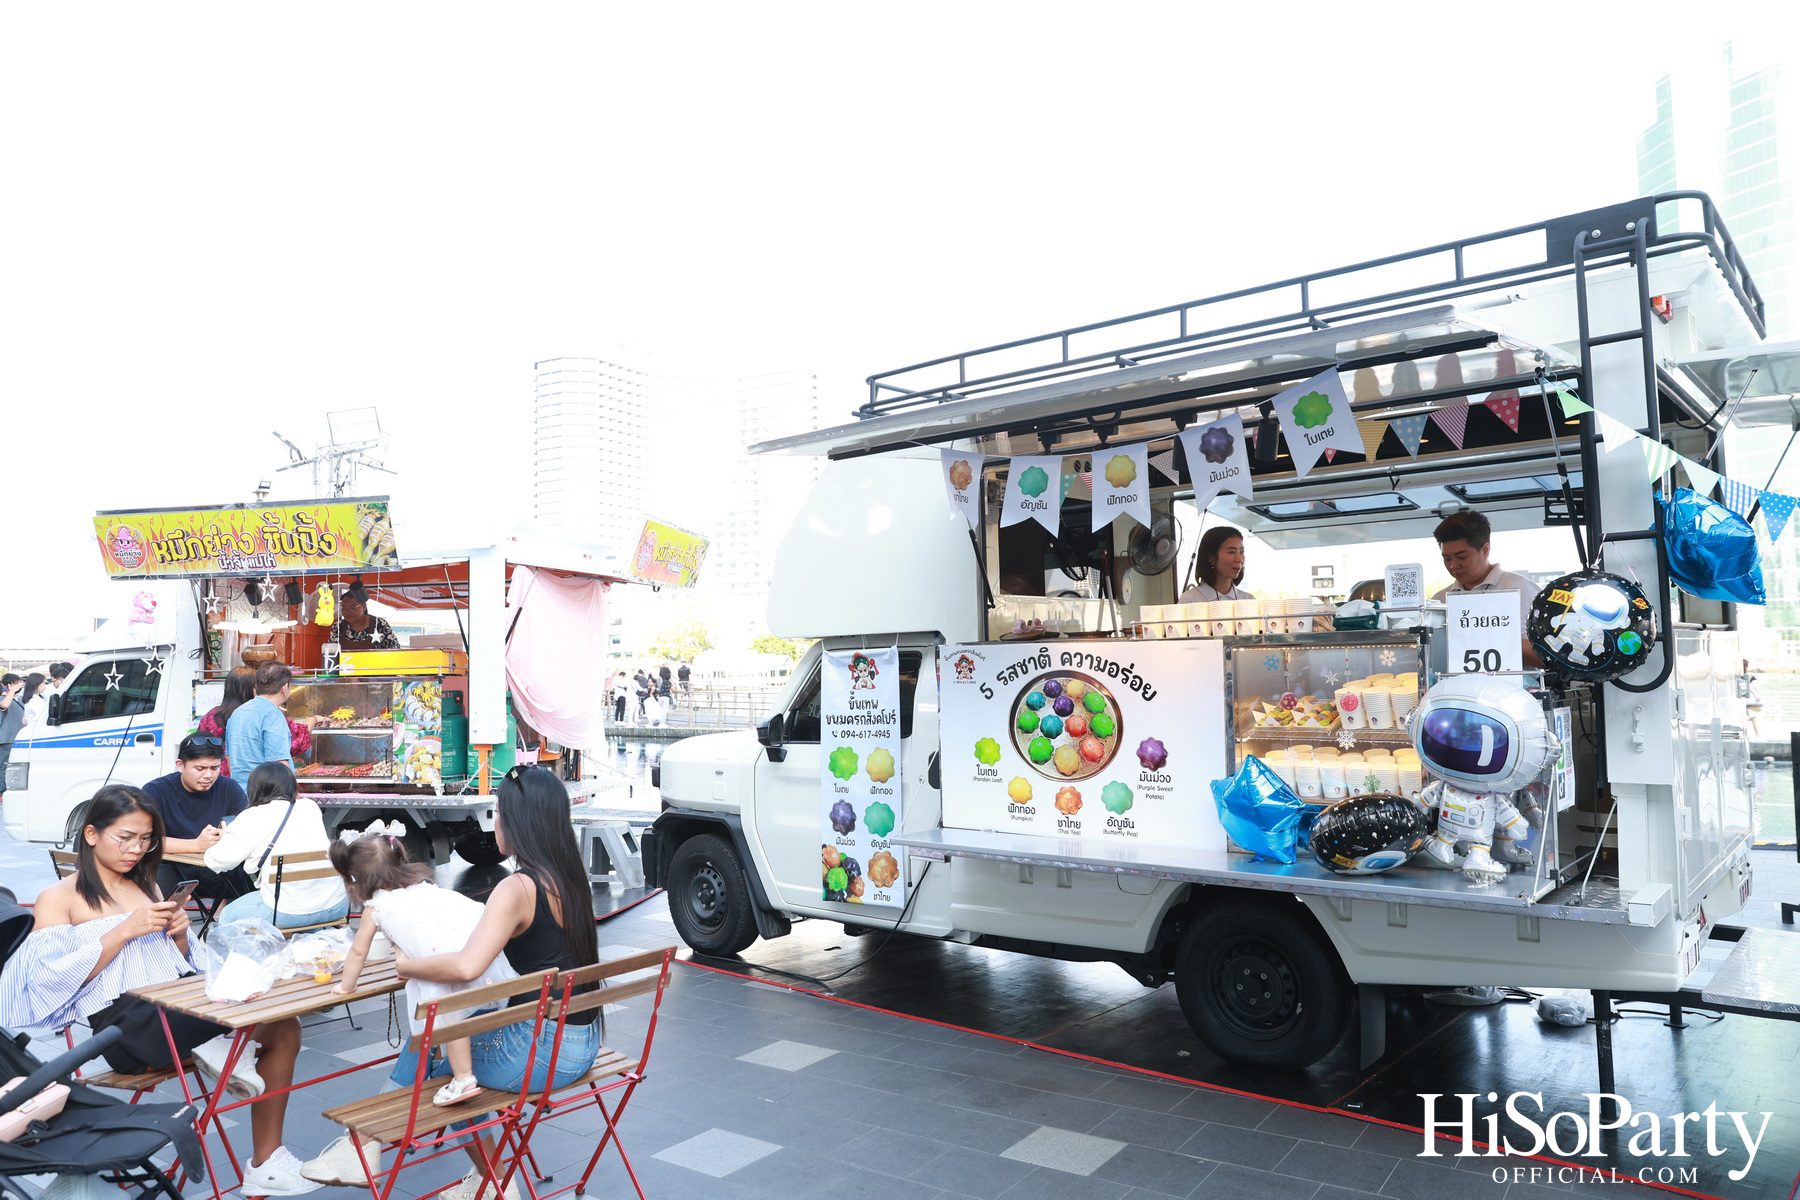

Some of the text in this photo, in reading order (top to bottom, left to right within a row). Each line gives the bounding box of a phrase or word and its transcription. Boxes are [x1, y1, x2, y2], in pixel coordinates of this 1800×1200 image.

[1304, 427, 1335, 446] ใบเตย
[1209, 466, 1240, 483] มันม่วง
[1020, 499, 1048, 512] อัญชัน
[1107, 494, 1138, 506] ฟักทอง
[151, 511, 338, 564] หมึกย่าง ชิ้นปิ้ง
[1552, 590, 1575, 604] YAY
[1460, 610, 1510, 629] ถ้วยละ
[979, 647, 1158, 701] 5 รสชาติ ความอร่อย
[848, 691, 879, 710] ขั้นเทพ
[826, 709, 897, 725] ขนมครกสิงคโปร์
[841, 730, 891, 739] 094-617-4945
[94, 738, 131, 746] CARRY
[976, 764, 998, 777] ใบเตย
[1139, 771, 1172, 783] มันม่วง
[834, 783, 893, 795] ใบเตย ฟักทอง
[1008, 803, 1036, 815] ฟักทอง
[1057, 816, 1082, 829] ชาไทย
[1106, 816, 1135, 831] อัญชัน
[836, 837, 891, 850] มันม่วง อัญชัน
[873, 890, 891, 902] ชาไทย
[462, 1191, 490, 1200] GUI
